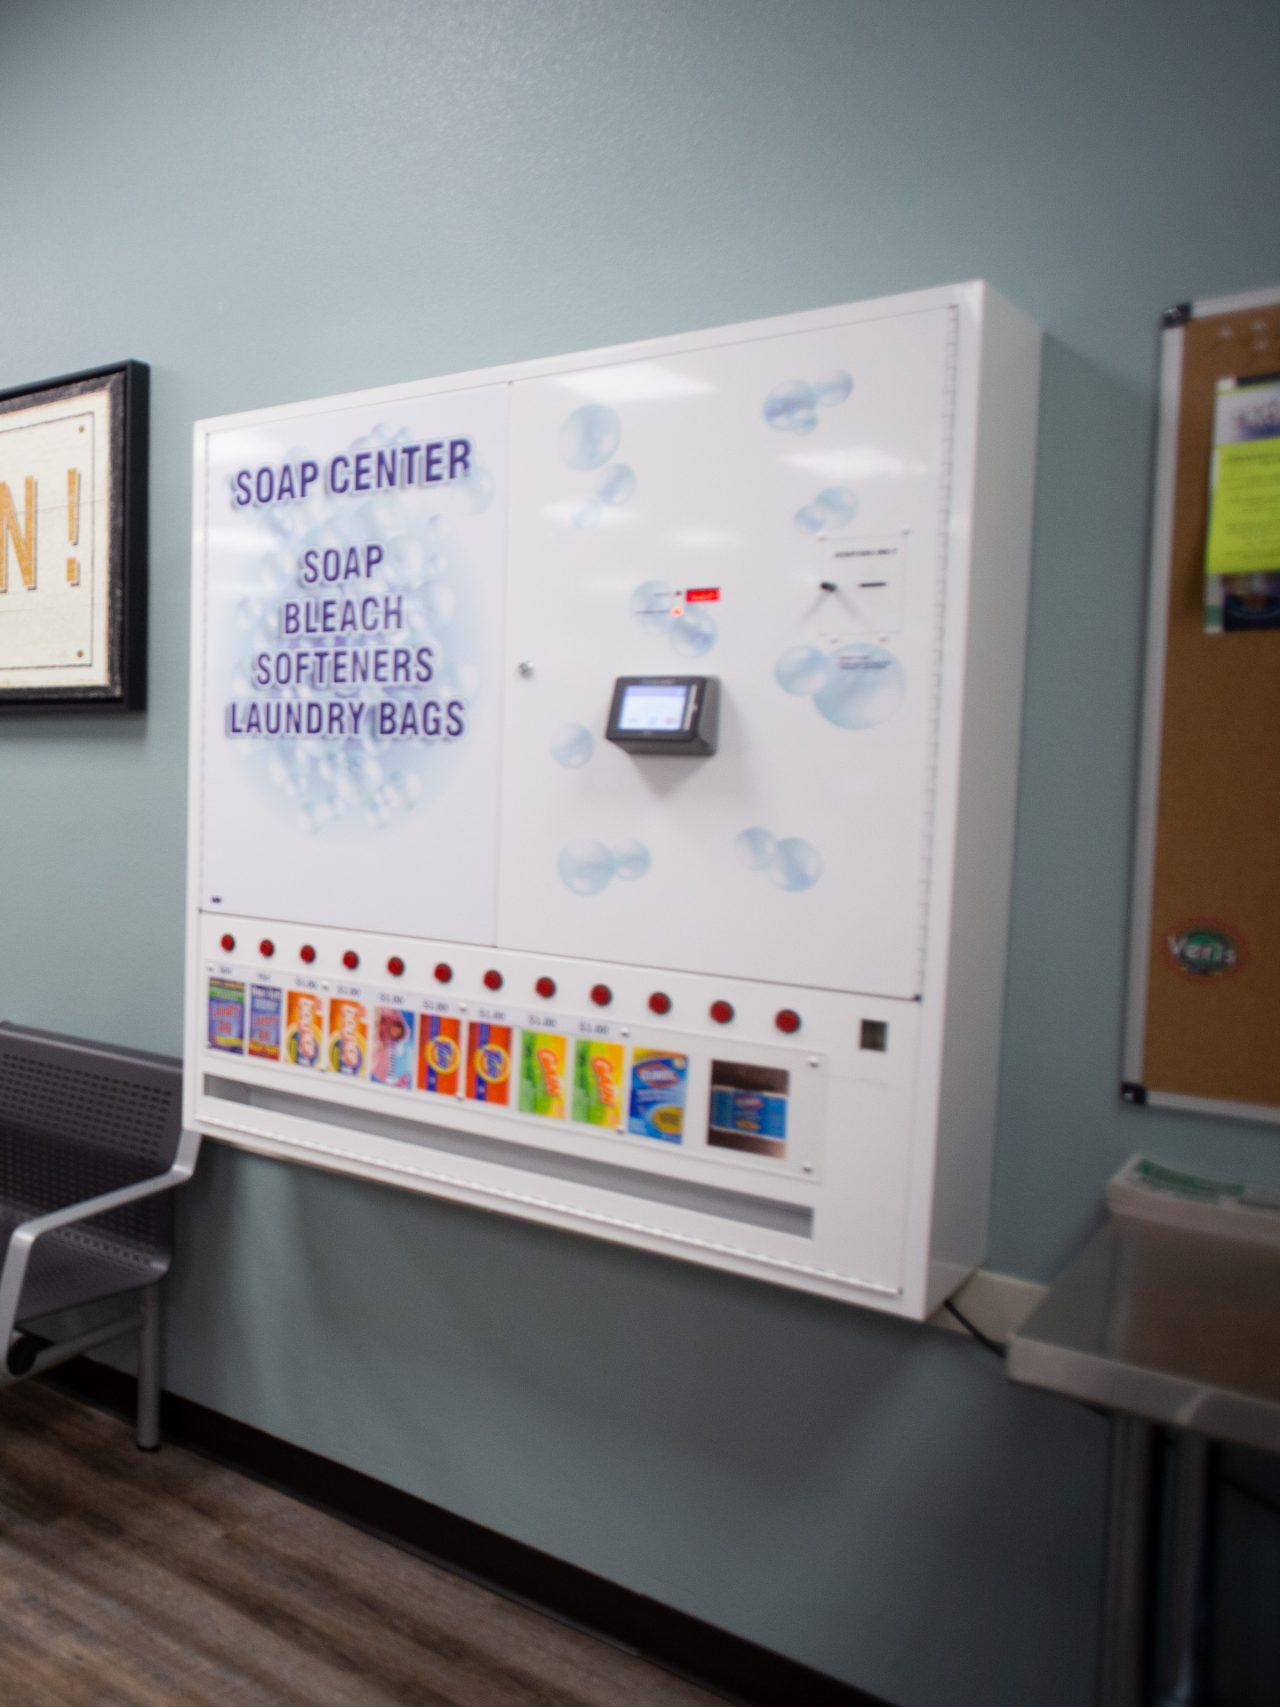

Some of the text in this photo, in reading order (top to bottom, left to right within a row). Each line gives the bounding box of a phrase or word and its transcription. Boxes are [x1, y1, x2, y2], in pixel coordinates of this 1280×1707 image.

[236, 439, 471, 505] SOAP CENTER
[304, 545, 383, 583] SOAP
[285, 596, 402, 634] BLEACH
[257, 647, 433, 684] SOFTENERS
[232, 701, 464, 736] LAUNDRY BAGS
